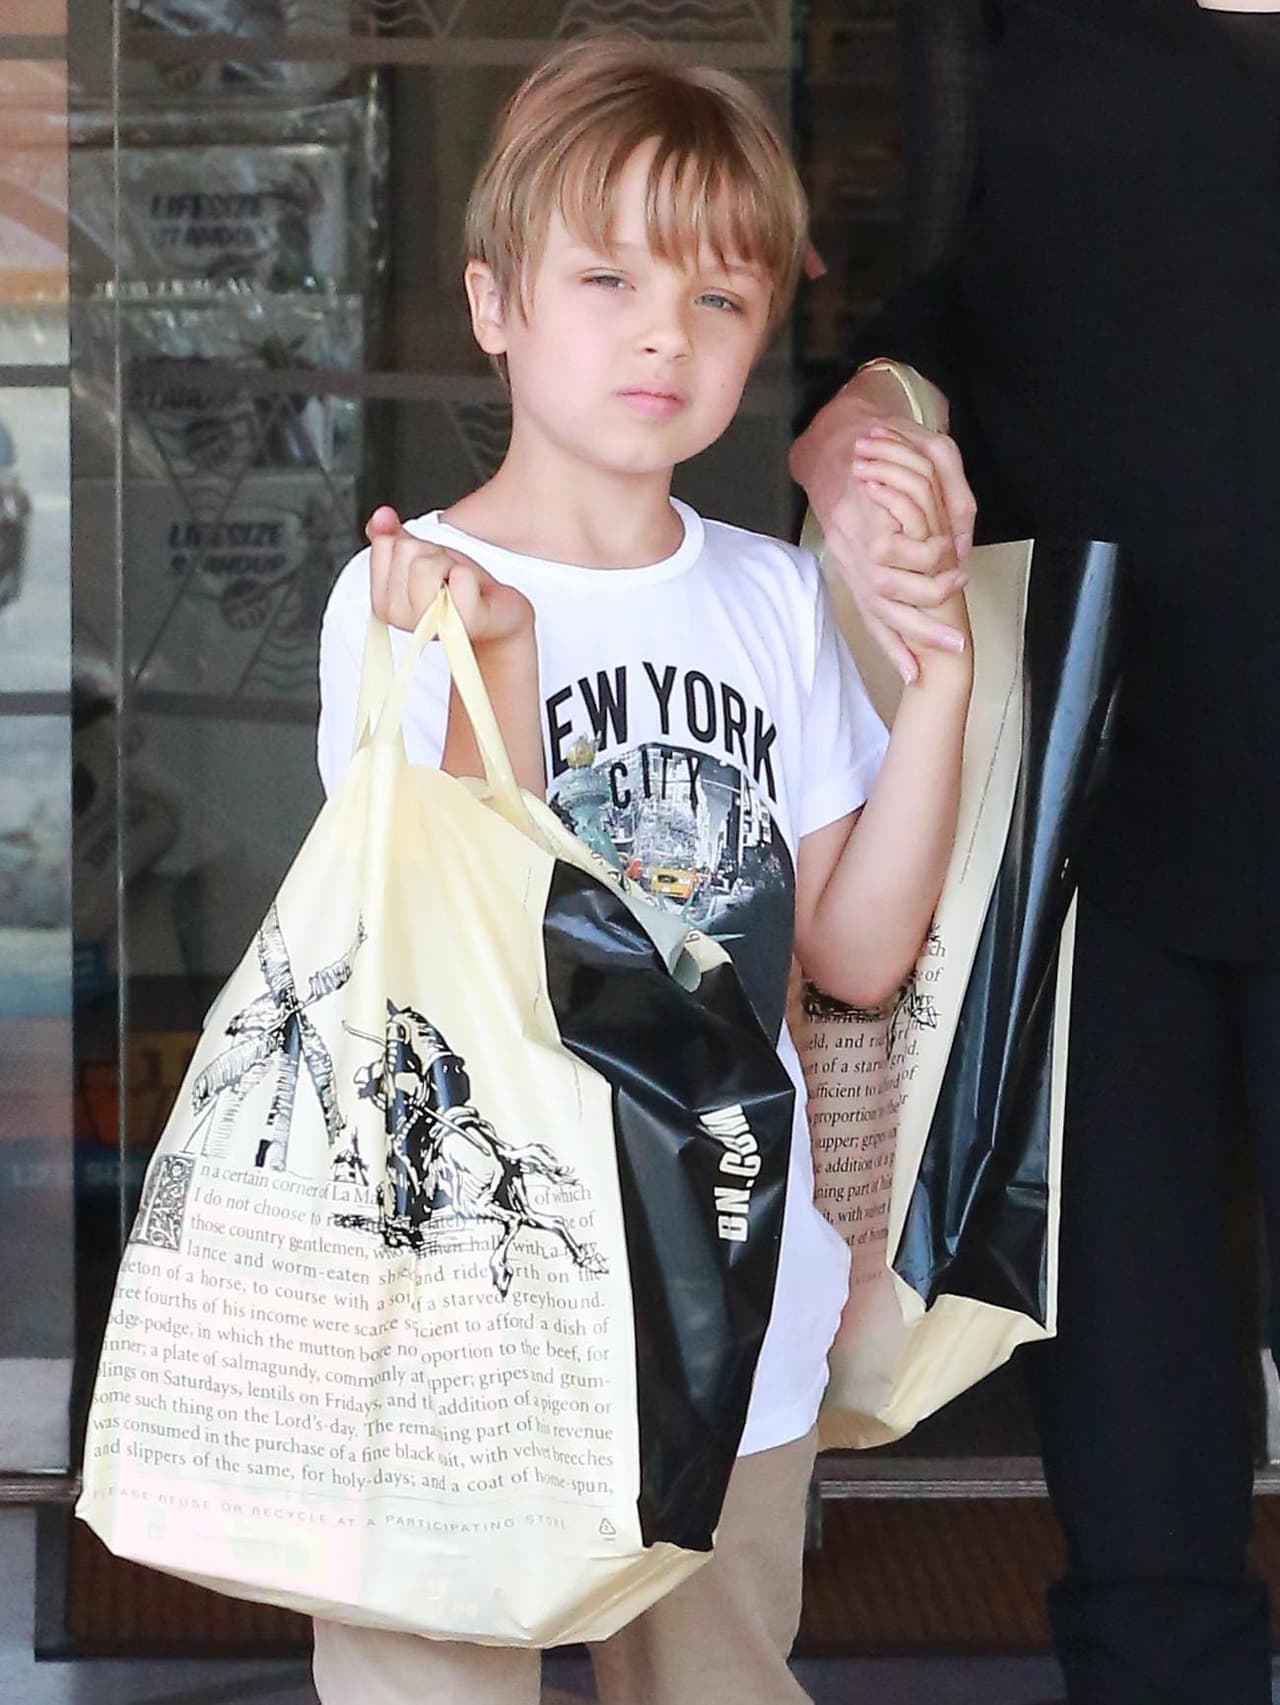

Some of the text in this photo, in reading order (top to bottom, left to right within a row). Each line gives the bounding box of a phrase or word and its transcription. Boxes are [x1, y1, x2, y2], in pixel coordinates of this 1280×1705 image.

[545, 661, 778, 805] EW YORK
[609, 748, 700, 819] CITY
[823, 1057, 838, 1073] of
[841, 1063, 849, 1073] a
[835, 1033, 864, 1049] and
[194, 1187, 201, 1202] I
[204, 1189, 222, 1205] do
[226, 1196, 250, 1212] not
[254, 1198, 306, 1222] choose
[212, 1167, 219, 1178] a
[222, 1168, 269, 1188] certain
[332, 1183, 350, 1201] La
[553, 1182, 591, 1202] which
[191, 1213, 226, 1234] those
[229, 1224, 286, 1249] country
[289, 1235, 369, 1261] gentlemen,
[186, 1239, 227, 1262] lance
[234, 1251, 264, 1269] and
[271, 1259, 369, 1286] worm-eaten
[453, 1261, 489, 1281] ride
[547, 1271, 570, 1283] on
[144, 1285, 198, 1311] fourths
[202, 1297, 218, 1315] of
[223, 1299, 245, 1319] his
[250, 1306, 308, 1328] income
[311, 1317, 350, 1334] were
[465, 1319, 482, 1333] to
[487, 1312, 535, 1332] afford
[540, 1319, 549, 1331] a
[553, 1317, 587, 1337] dish
[592, 1316, 610, 1335] of
[166, 1264, 182, 1281] of
[186, 1271, 194, 1283] a
[200, 1268, 247, 1294] horse,
[253, 1281, 268, 1296] to
[274, 1285, 328, 1305] course
[334, 1292, 369, 1312] with
[376, 1299, 386, 1312] a
[427, 1300, 437, 1312] a
[512, 1291, 605, 1310] greyhound.
[198, 1321, 211, 1340] in
[217, 1325, 264, 1347] which
[269, 1332, 295, 1351] the
[299, 1340, 355, 1361] mutton
[397, 1343, 418, 1357] no
[499, 1342, 516, 1356] to
[521, 1337, 540, 1357] the
[546, 1340, 581, 1363] beef,
[587, 1344, 610, 1363] for
[150, 1345, 159, 1357] a
[163, 1342, 199, 1364] plate
[203, 1349, 219, 1367] of
[221, 1353, 321, 1385] salmagundy,
[410, 1370, 424, 1384] at
[479, 1367, 529, 1391] gripes
[560, 1373, 611, 1390] grum-
[92, 1389, 131, 1405] some
[135, 1393, 167, 1412] such
[172, 1397, 214, 1422] thing
[217, 1409, 237, 1422] on
[244, 1406, 269, 1425] the
[275, 1409, 359, 1441] Lord's-day.
[363, 1418, 394, 1438] The
[476, 1421, 512, 1443] part
[516, 1415, 532, 1433] of
[553, 1424, 614, 1440] revenue
[140, 1369, 159, 1384] on
[163, 1369, 243, 1399] Saturdays,
[248, 1380, 295, 1403] lentils
[299, 1393, 320, 1406] on
[386, 1393, 416, 1409] and
[438, 1394, 508, 1417] addition
[513, 1389, 530, 1407] of
[541, 1394, 590, 1417] pigeon
[594, 1402, 614, 1415] or
[93, 1416, 120, 1431] was
[123, 1418, 201, 1442] consumed
[205, 1426, 219, 1445] in
[225, 1431, 250, 1449] the
[255, 1437, 325, 1459] purchase
[329, 1444, 346, 1462] of
[348, 1451, 357, 1463] a
[361, 1444, 391, 1464] fine
[395, 1442, 435, 1463] black
[470, 1445, 508, 1466] with
[552, 1445, 614, 1467] breeches
[93, 1438, 121, 1458] and
[127, 1440, 186, 1466] slippers
[193, 1450, 211, 1468] of
[215, 1455, 241, 1475] the
[247, 1462, 295, 1481] same,
[302, 1463, 324, 1482] for
[331, 1466, 416, 1491] holy-days;
[421, 1474, 446, 1491] and
[450, 1480, 460, 1493] a
[466, 1473, 504, 1493] coat
[511, 1466, 529, 1484] of
[221, 1500, 243, 1513] OR
[252, 1506, 328, 1524] RECYCLE
[337, 1516, 355, 1528] AT
[366, 1517, 376, 1528] A
[385, 1513, 516, 1534] PARTICIPATING
